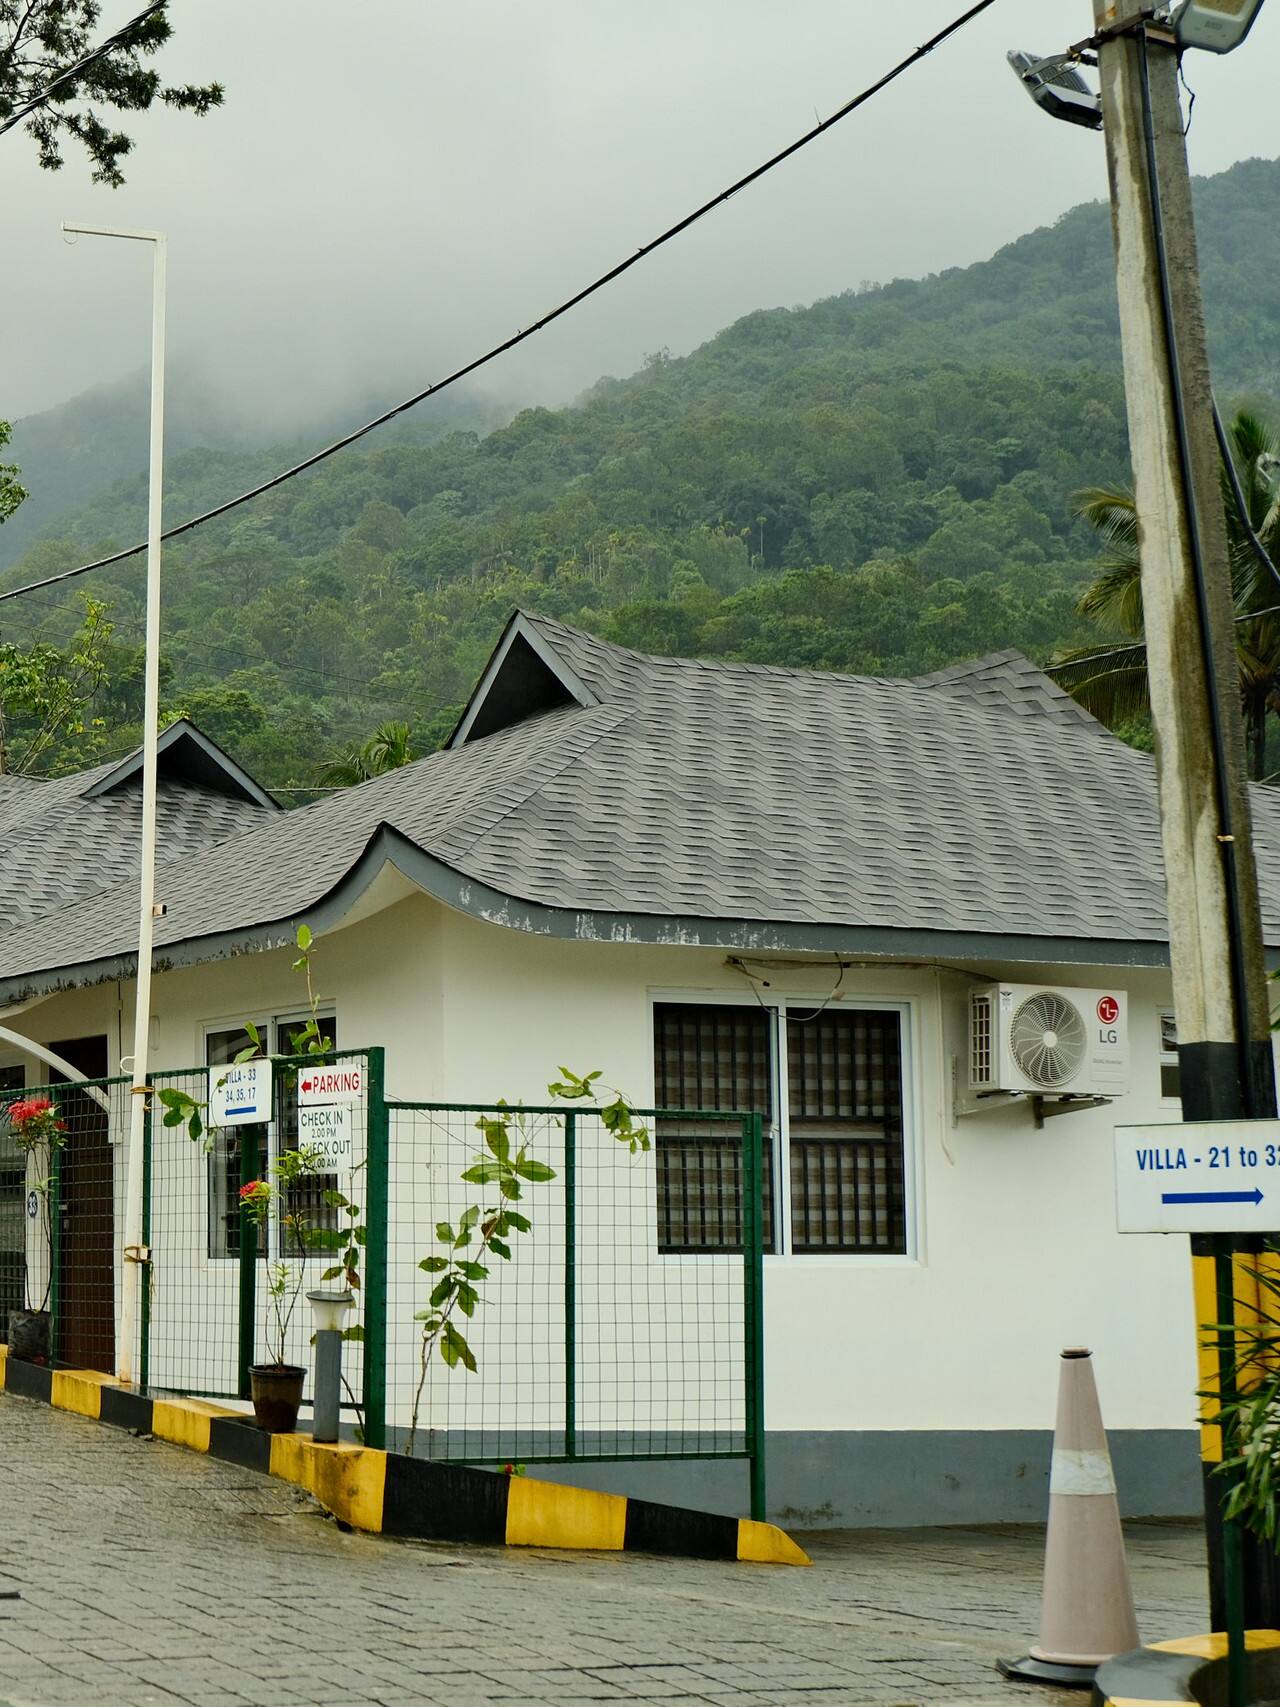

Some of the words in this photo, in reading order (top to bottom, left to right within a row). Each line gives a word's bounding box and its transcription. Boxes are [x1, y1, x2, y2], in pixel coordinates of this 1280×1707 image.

[1099, 1029, 1117, 1043] LG
[248, 1068, 256, 1081] 33
[313, 1072, 360, 1093] PARKING
[248, 1087, 256, 1099] 17
[301, 1111, 332, 1126] CHECK
[333, 1110, 343, 1124] IN
[311, 1128, 325, 1138] 2.00
[326, 1127, 337, 1137] PM
[332, 1140, 351, 1155] OUT
[326, 1158, 338, 1168] AM
[1136, 1148, 1187, 1170] VILLA
[1208, 1146, 1230, 1168] 21
[1239, 1146, 1257, 1167] to
[1265, 1144, 1280, 1166] 3
